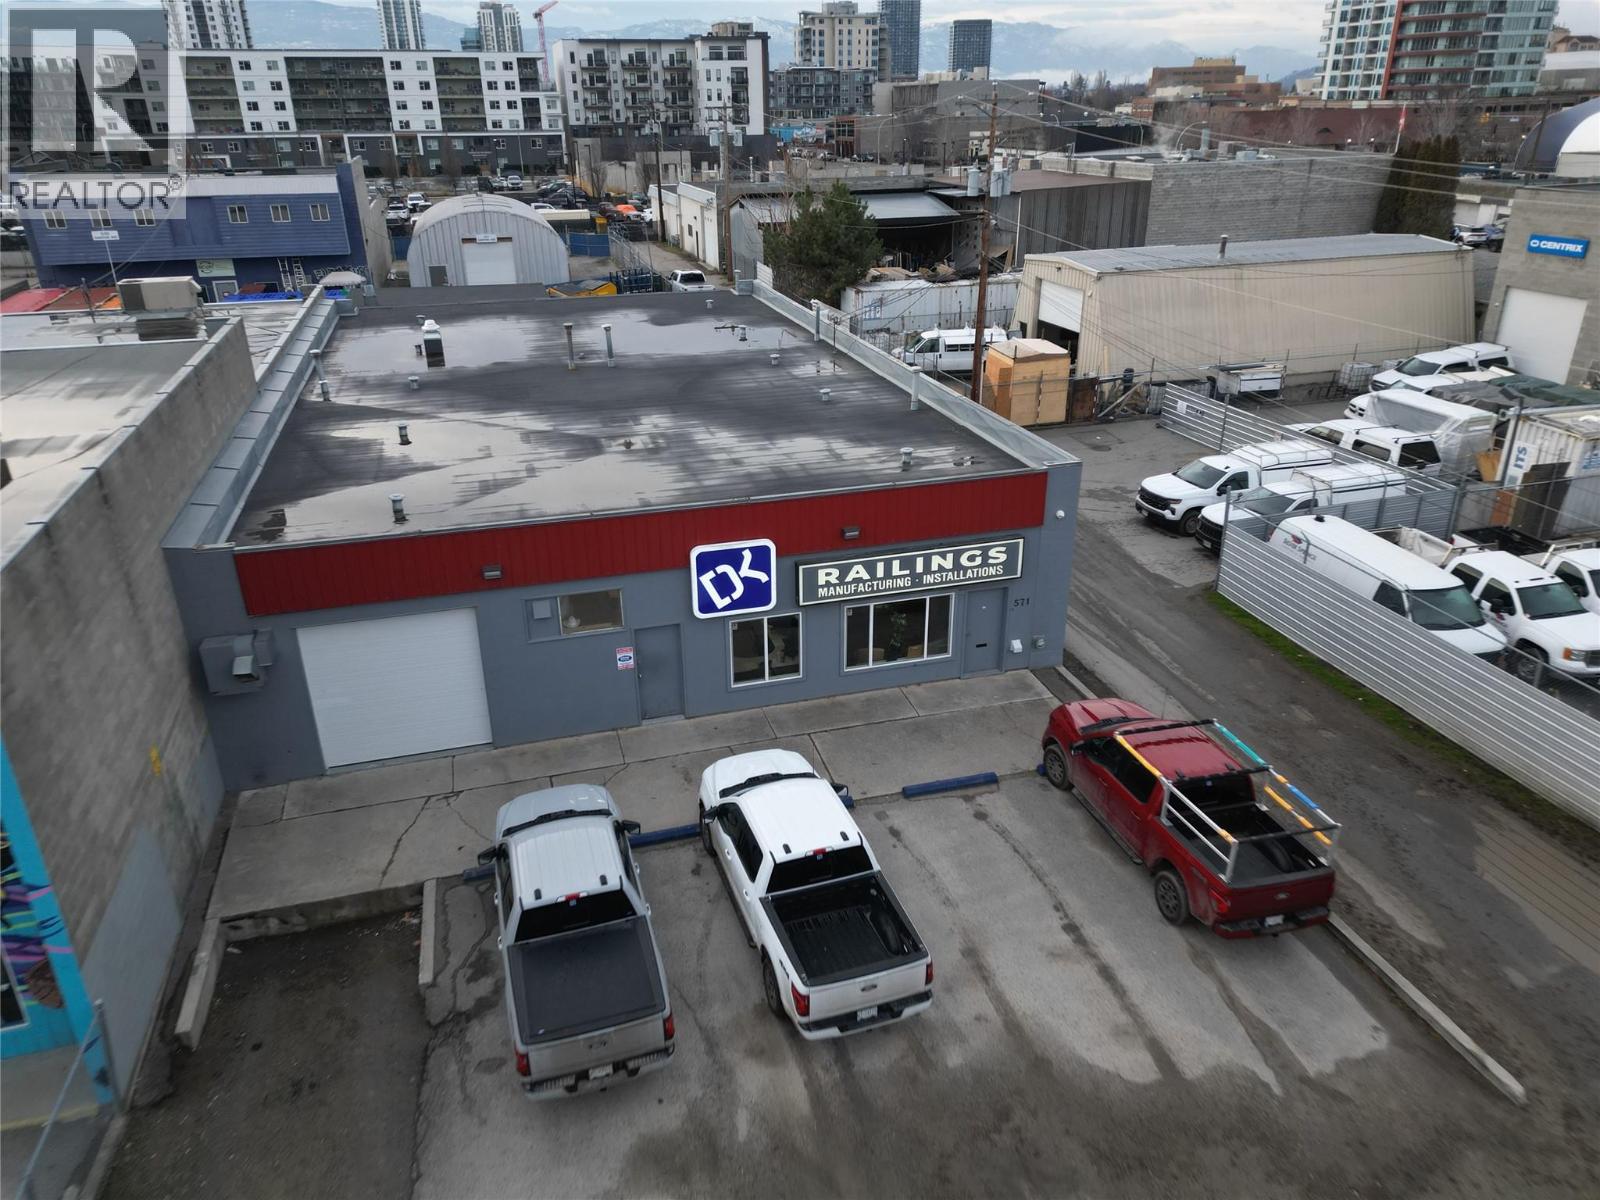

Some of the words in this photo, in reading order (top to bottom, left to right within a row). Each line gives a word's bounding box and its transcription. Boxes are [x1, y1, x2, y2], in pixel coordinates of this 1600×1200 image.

[1540, 240, 1584, 253] CENTRIX
[698, 548, 770, 610] DK
[817, 546, 1008, 586] RAILINGS
[818, 576, 912, 598] MANUFACTURING
[923, 564, 1004, 585] INSTALLATIONS
[1013, 598, 1030, 608] 571
